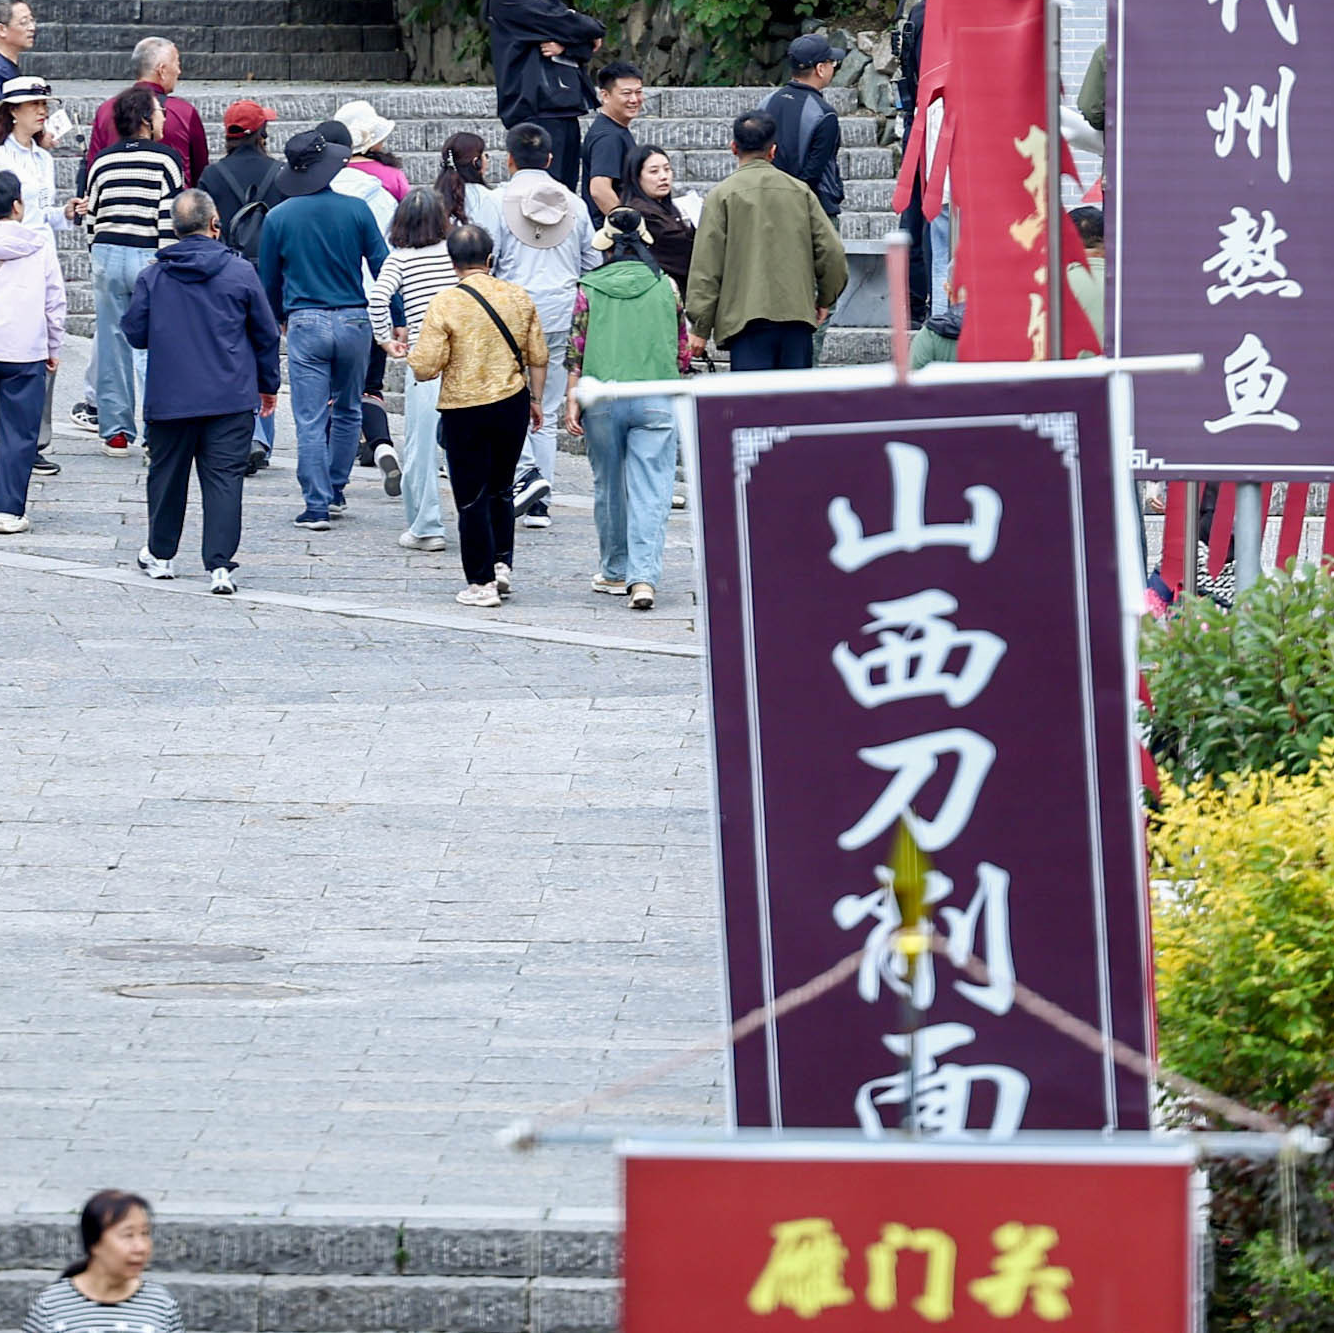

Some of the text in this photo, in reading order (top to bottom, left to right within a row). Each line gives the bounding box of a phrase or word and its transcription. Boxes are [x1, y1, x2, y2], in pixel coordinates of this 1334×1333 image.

[828, 441, 1031, 1139] 山西刀削面
[747, 1215, 1072, 1323] 雁门关
